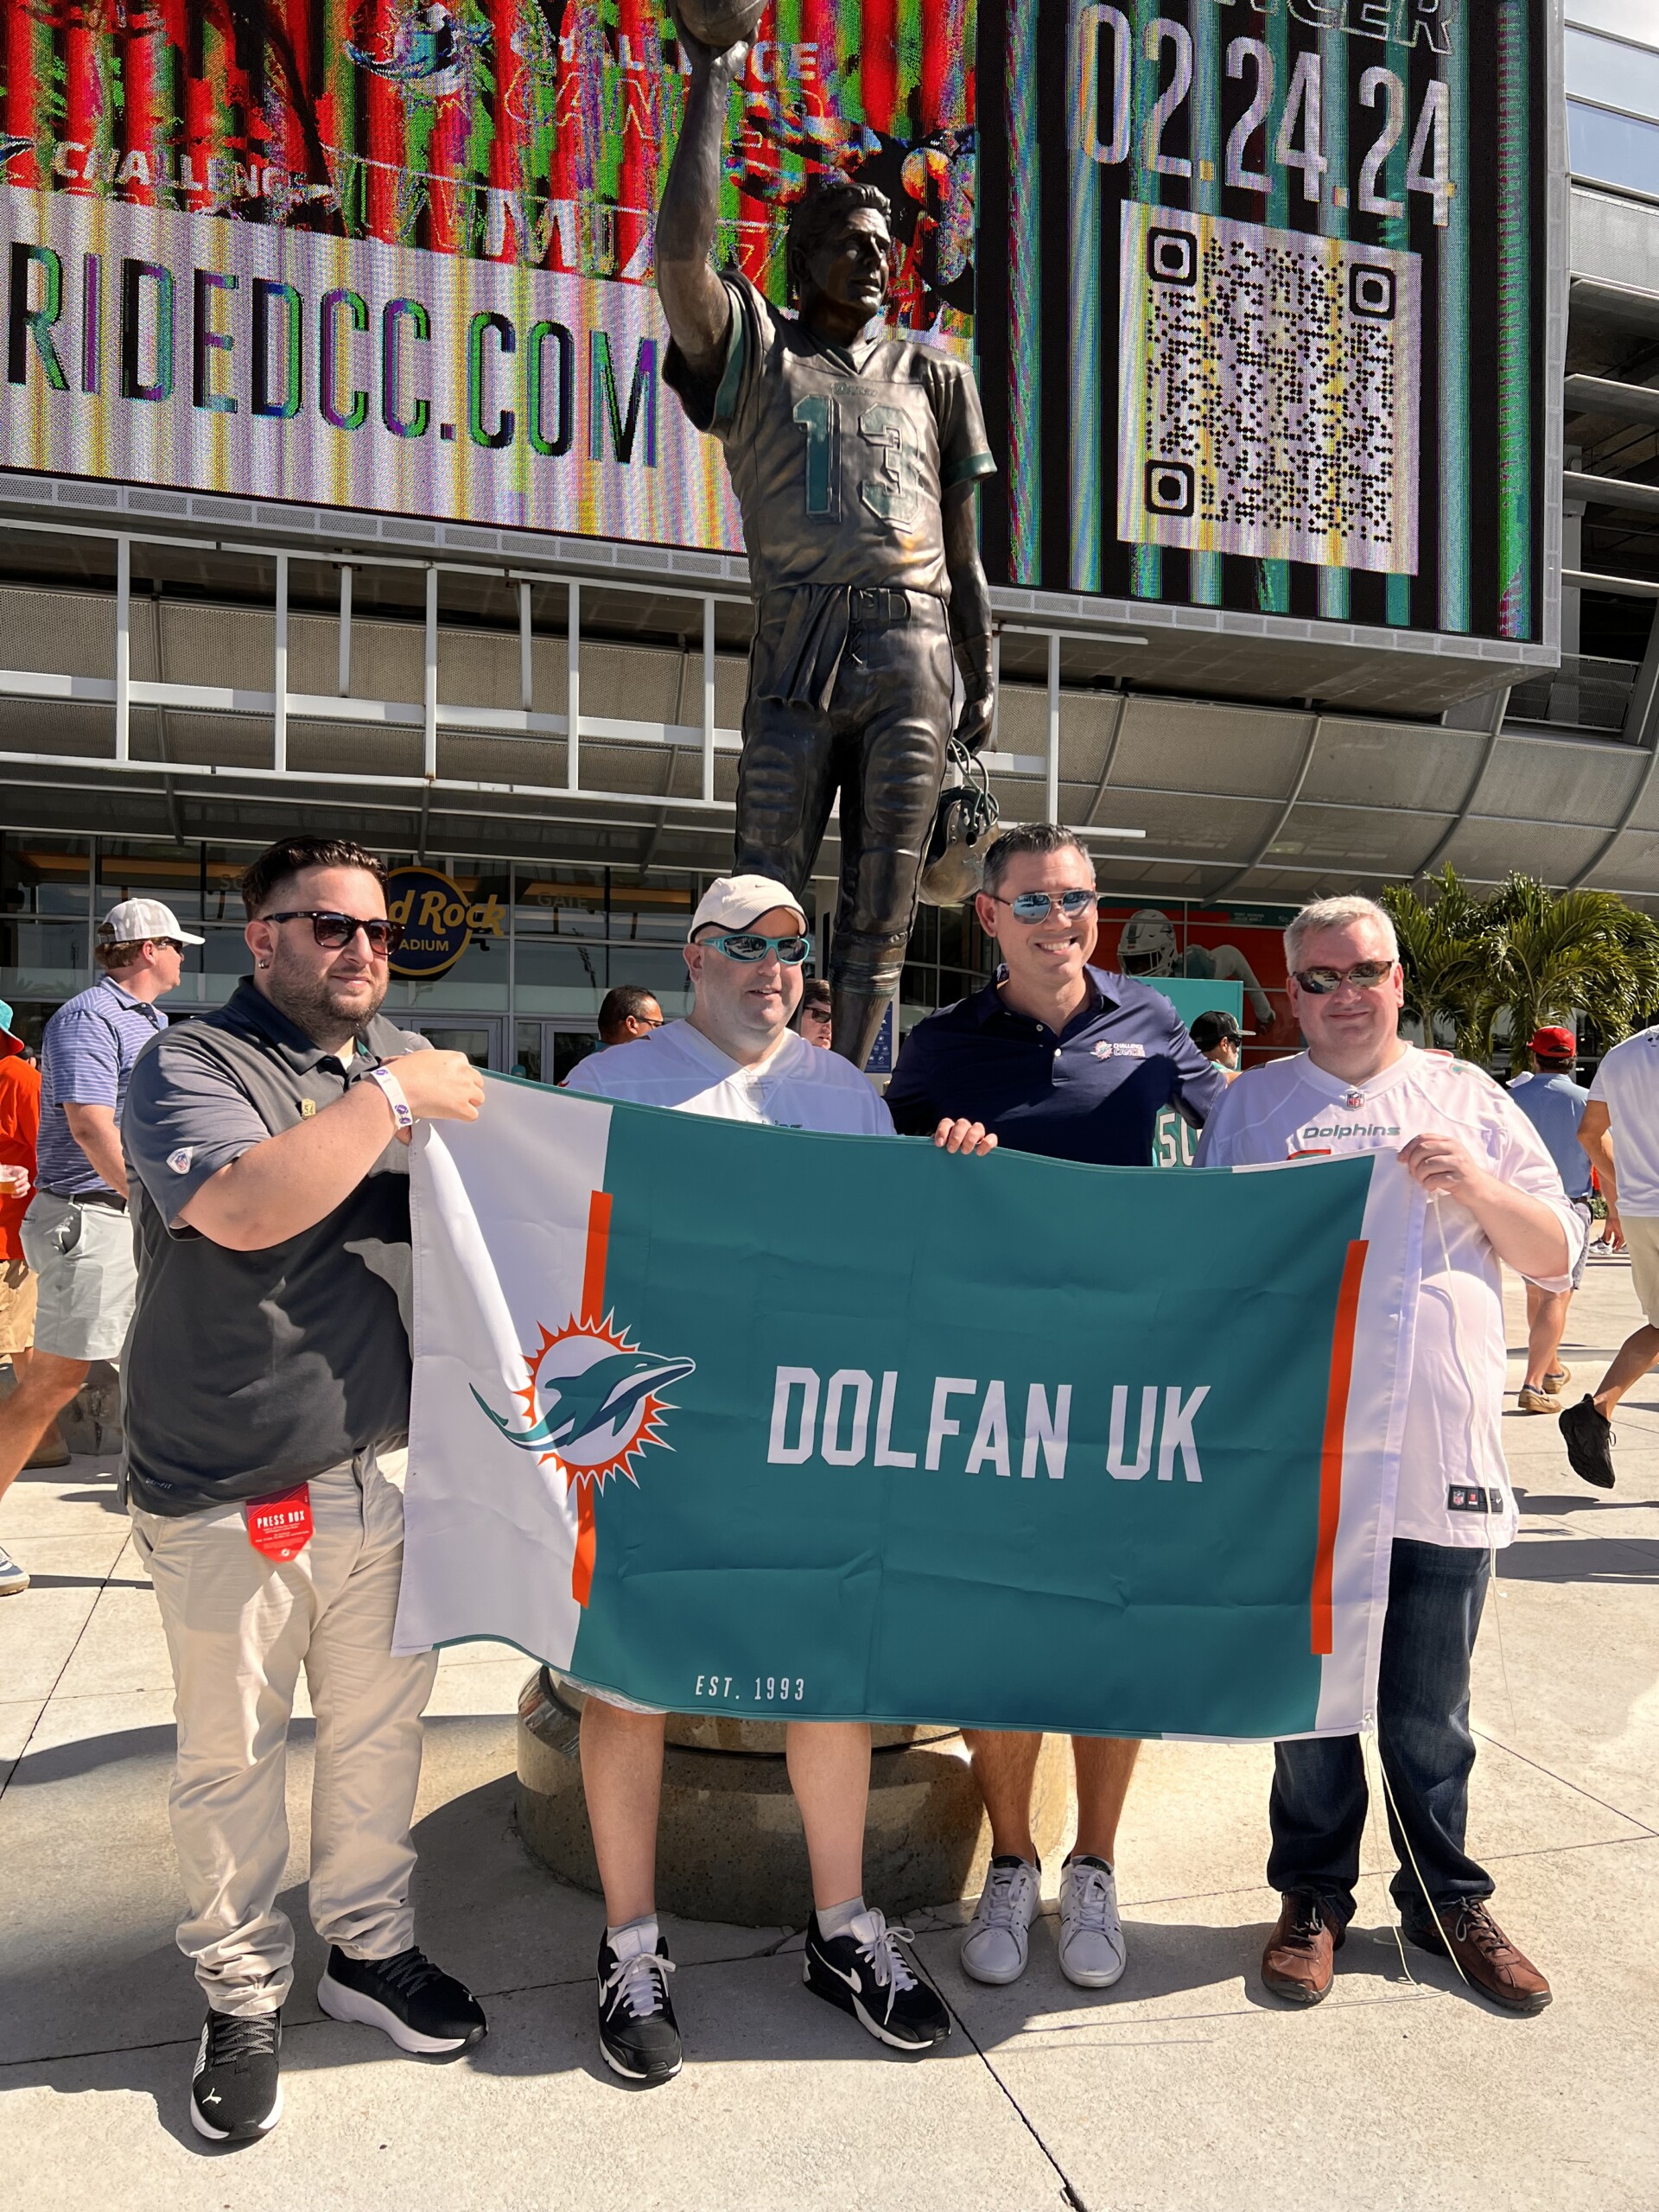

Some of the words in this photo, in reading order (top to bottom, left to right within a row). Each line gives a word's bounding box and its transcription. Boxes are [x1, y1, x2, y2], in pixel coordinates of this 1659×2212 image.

[1079, 3, 1457, 226] 02.24.24
[8, 241, 658, 468] RIDEDCC.COM
[792, 394, 923, 533] 13
[418, 891, 506, 937] Rock
[398, 939, 449, 951] ADIUM
[1303, 1123, 1401, 1140] Dolphins
[767, 1365, 1072, 1480] DOLFAN
[1106, 1384, 1211, 1483] UK
[257, 1514, 285, 1529] PRESS
[288, 1510, 305, 1523] BOX
[695, 1675, 740, 1700] EST.
[754, 1677, 804, 1700] 1993
